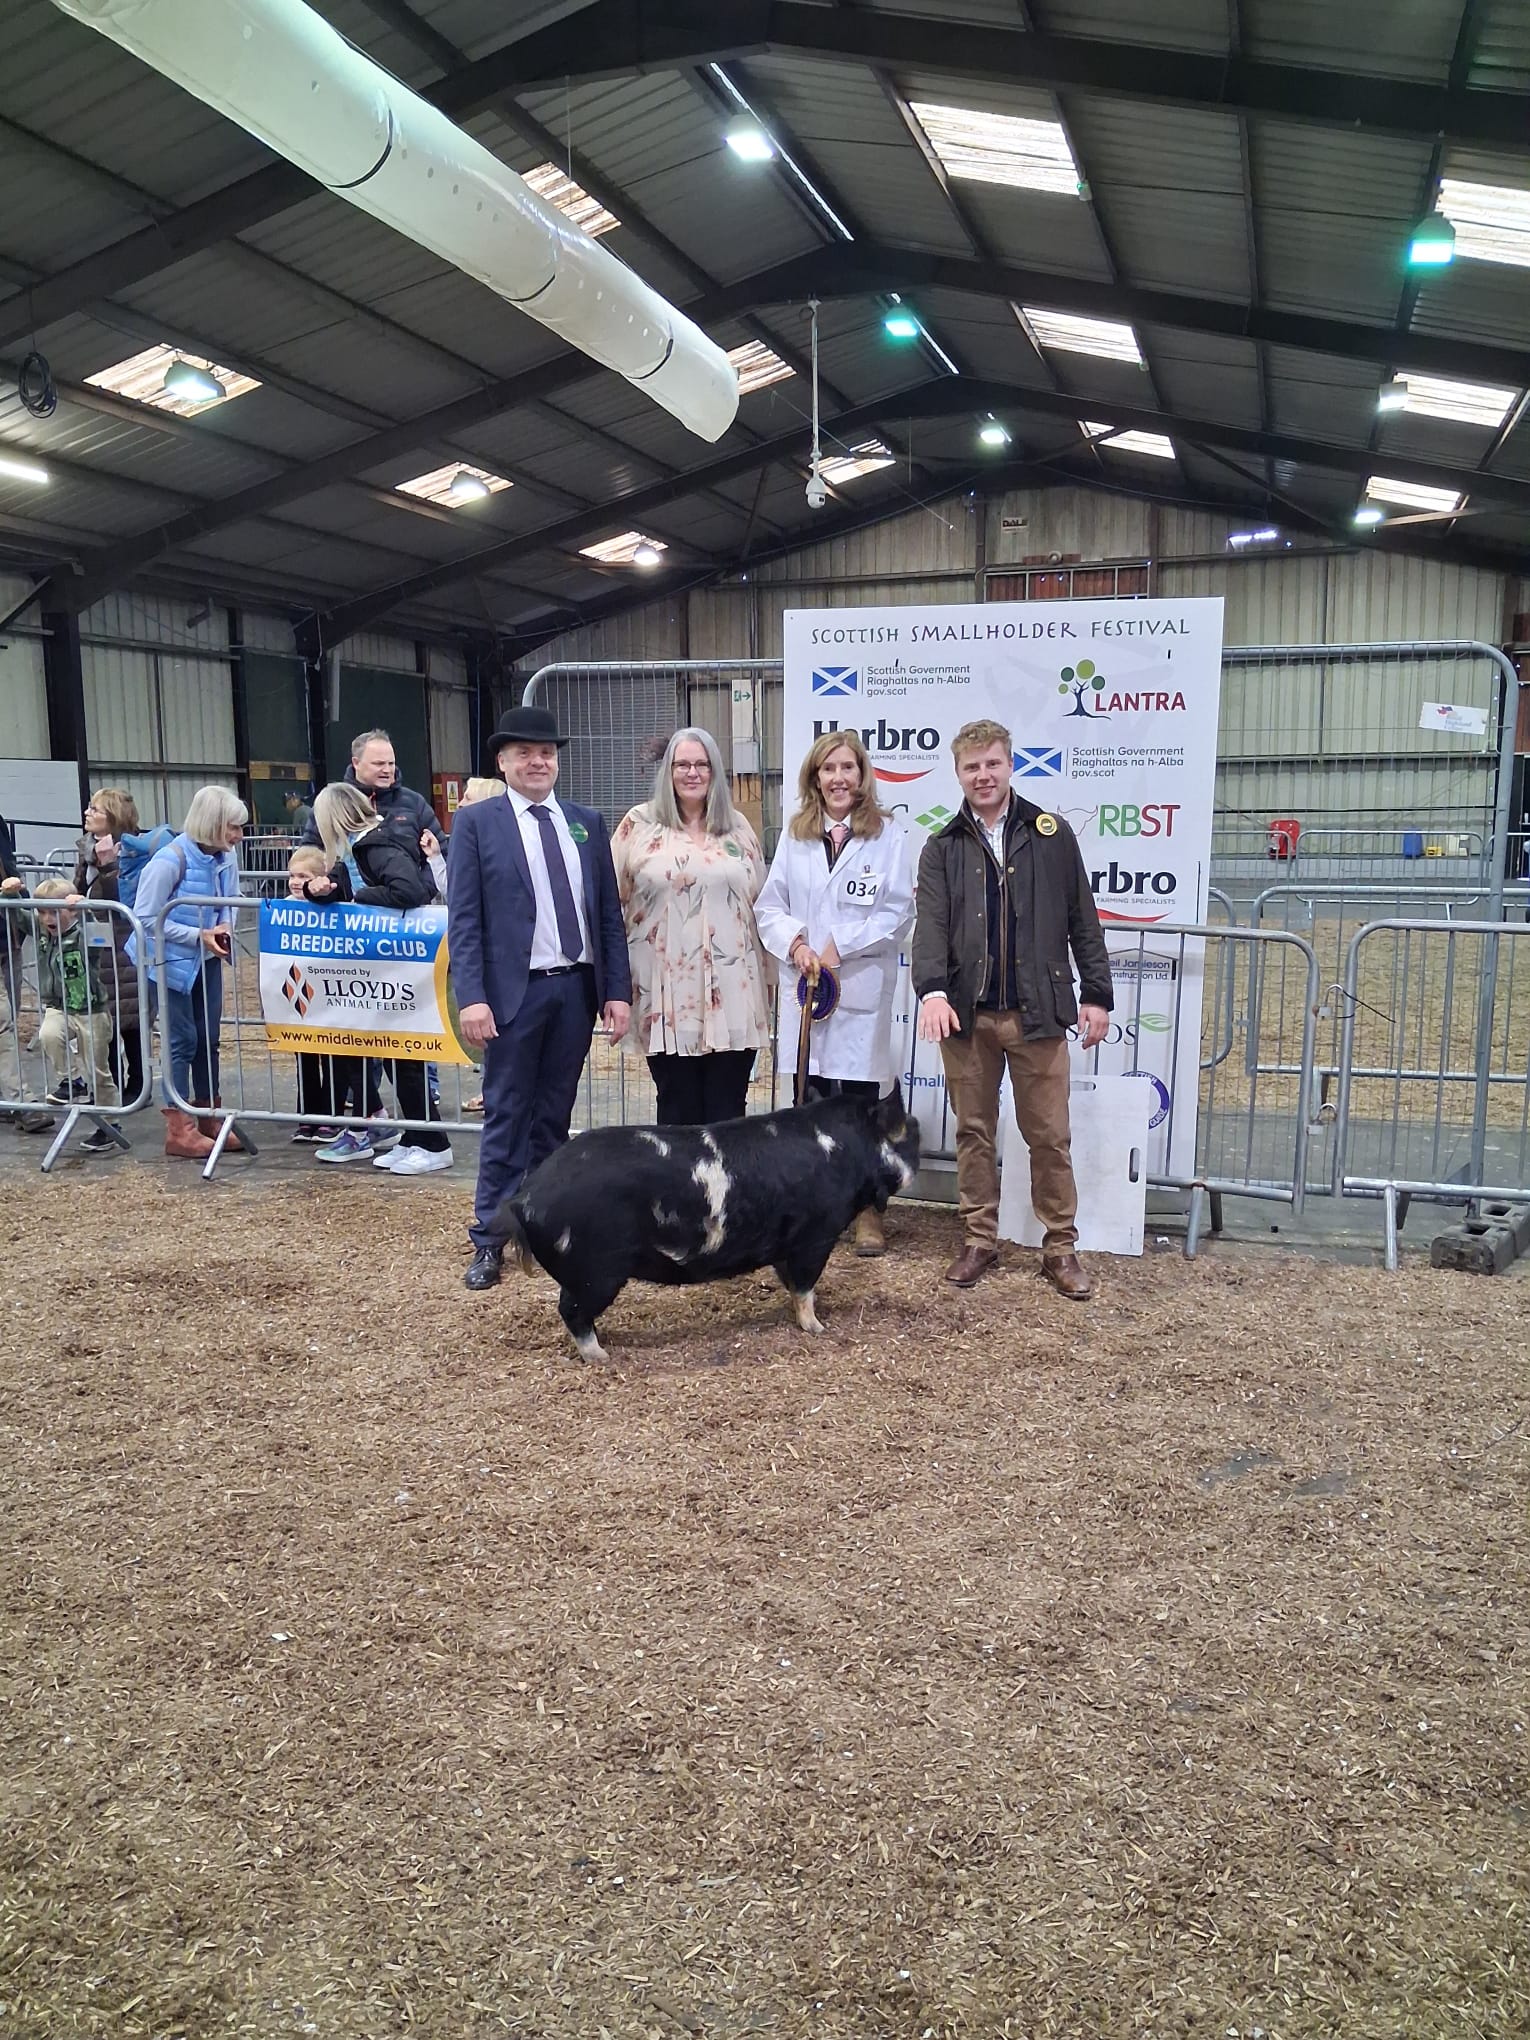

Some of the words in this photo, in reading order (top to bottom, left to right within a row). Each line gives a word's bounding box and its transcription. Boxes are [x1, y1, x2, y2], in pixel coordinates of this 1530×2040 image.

[812, 627, 899, 644] SCOTTISH
[911, 622, 1077, 643] SMALLHOLDER
[1091, 619, 1190, 637] FESTIVAL
[867, 666, 906, 675] Scottish
[909, 665, 970, 674] Government
[867, 675, 919, 687] Riaghaltas
[937, 675, 970, 684] h-Alba
[867, 687, 907, 697] gov.scot
[1095, 692, 1186, 711] LANTRA
[813, 719, 940, 751] Hrbro
[1072, 747, 1114, 756] Scottish
[1117, 747, 1184, 756] Government
[1072, 757, 1128, 769] Riaghaltas
[1147, 757, 1184, 766] h-Alba
[1072, 769, 1114, 780] gov.scot
[1099, 804, 1181, 837] RBST
[1091, 862, 1177, 895] rbro
[847, 880, 877, 897] 034
[270, 908, 338, 930] MIDDLE
[344, 913, 399, 934] WHITE
[404, 917, 437, 935] PIG
[281, 933, 370, 955] BREEDERS'
[377, 938, 427, 957] CLUB
[307, 966, 356, 977] Sponsored
[359, 968, 370, 977] by
[323, 979, 415, 1001] LLOYD'S
[326, 998, 372, 1009] ANIMAL
[377, 1003, 416, 1011] FEEDS
[281, 1031, 442, 1052] www.middlewhite.co.uk
[1065, 1023, 1137, 1046] SOS
[904, 1073, 944, 1088] Small
